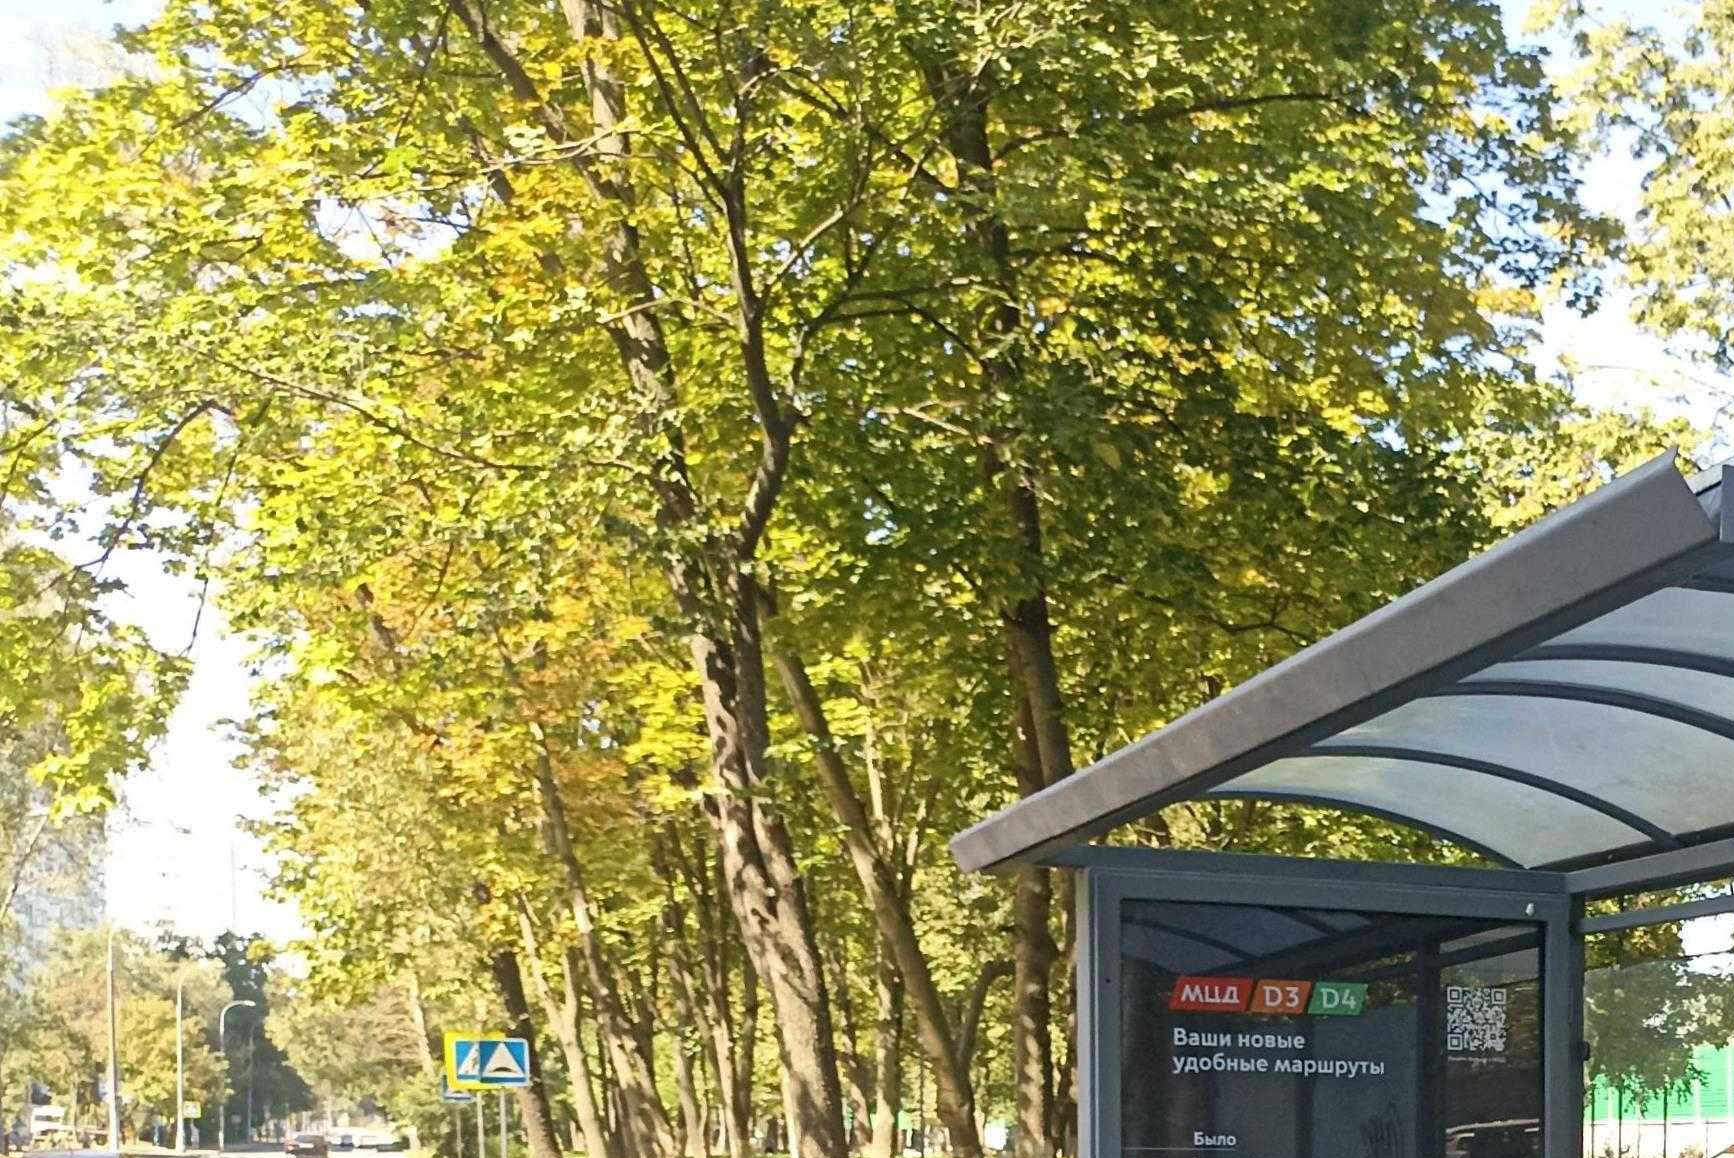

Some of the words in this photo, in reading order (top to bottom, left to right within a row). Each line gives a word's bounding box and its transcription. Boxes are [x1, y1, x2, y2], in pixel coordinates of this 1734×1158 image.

[1181, 984, 1240, 1004] МЦД
[1263, 986, 1300, 1007] D3
[1320, 988, 1357, 1009] D4
[1173, 1027, 1232, 1047] Ваши
[1238, 1032, 1306, 1049] новые
[1172, 1053, 1269, 1074] удобные
[1274, 1058, 1385, 1078] маршруты
[1193, 1131, 1237, 1146] Было
